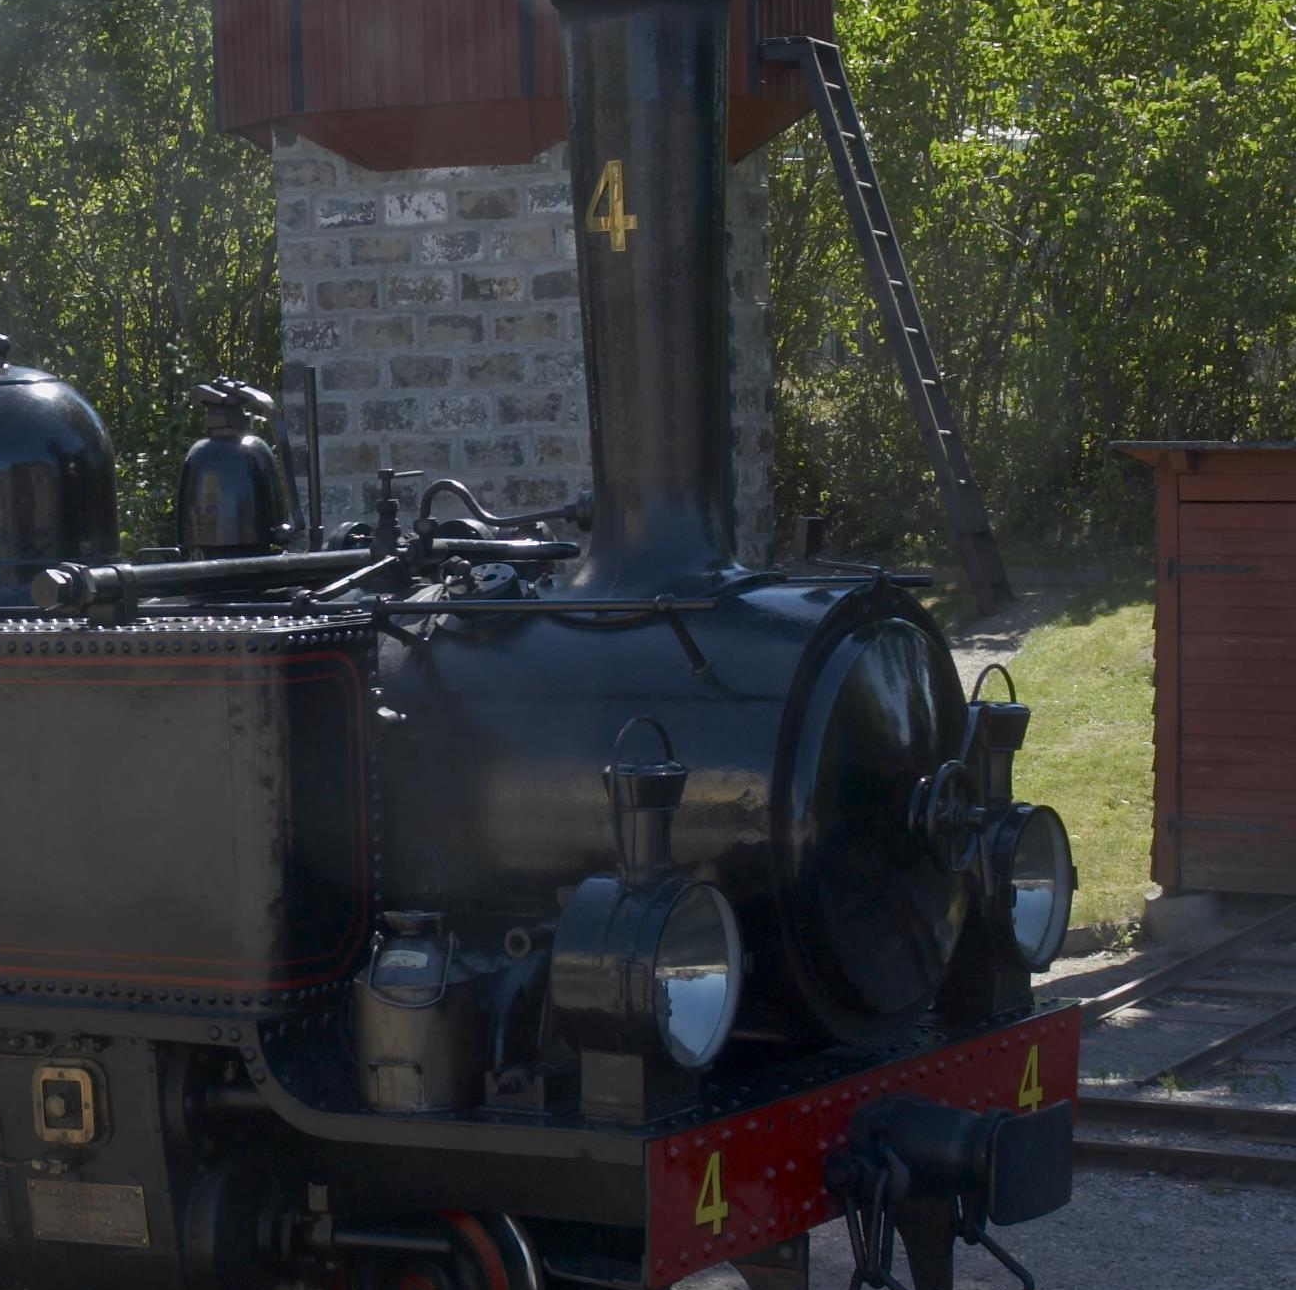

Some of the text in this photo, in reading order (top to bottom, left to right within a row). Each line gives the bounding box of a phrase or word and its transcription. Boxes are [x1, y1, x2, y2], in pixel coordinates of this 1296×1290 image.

[585, 160, 638, 252] 4
[1019, 1044, 1043, 1113] 4
[695, 1151, 728, 1235] 4
